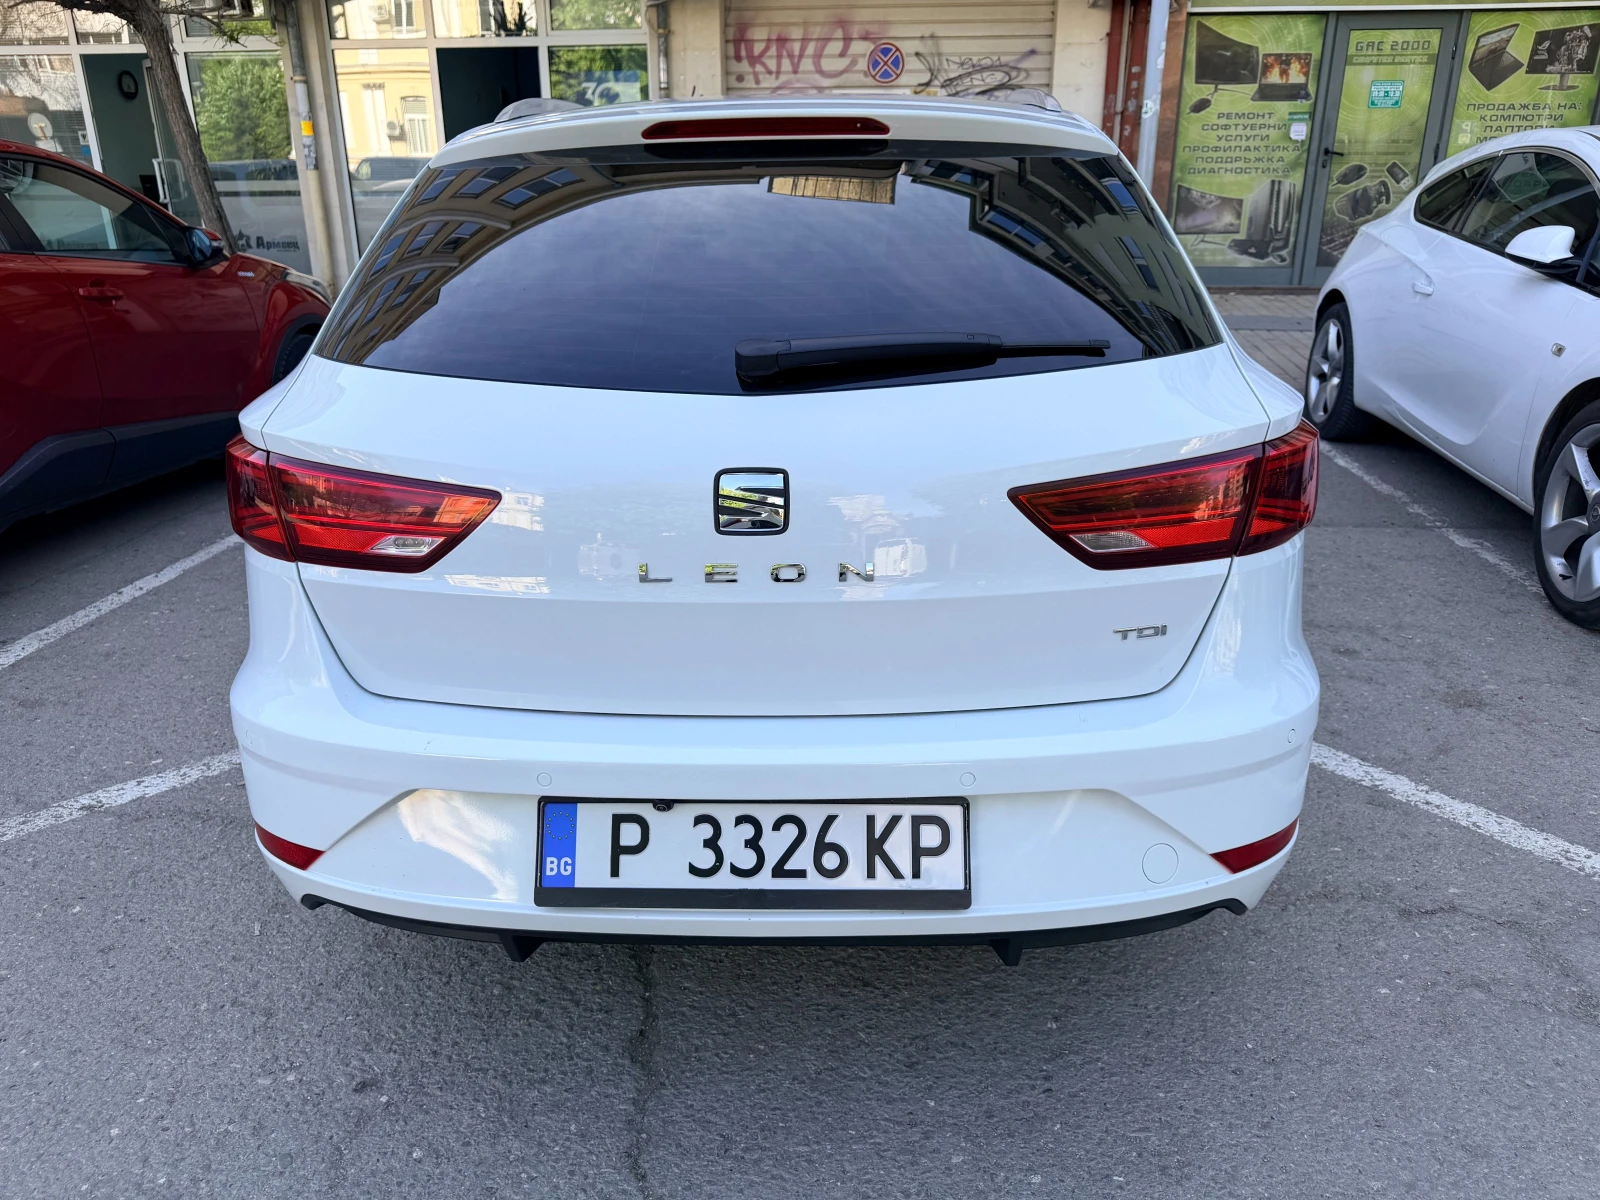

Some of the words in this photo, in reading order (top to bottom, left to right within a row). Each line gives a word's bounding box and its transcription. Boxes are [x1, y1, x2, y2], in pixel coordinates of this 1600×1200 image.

[1355, 41, 1384, 52] GAC
[1390, 40, 1431, 51] 2000
[1466, 103, 1552, 111] ПРОДАЖБА
[1557, 102, 1582, 111] НА:
[1217, 112, 1274, 120] РЕМОНТ
[1480, 114, 1564, 122] КОМПЮТРИ
[1201, 123, 1287, 131] СОФТУЕРНИ
[1216, 134, 1270, 142] УСЛУГИ
[1182, 145, 1301, 153] ПРОФИЛАКТИКА
[1187, 167, 1291, 175] ДИАГНОСТИКА
[637, 562, 875, 583] LEON
[1113, 623, 1167, 640] TDI
[610, 813, 650, 878] P
[688, 813, 849, 879] 3326
[866, 814, 951, 880] KP
[545, 856, 573, 877] BG
